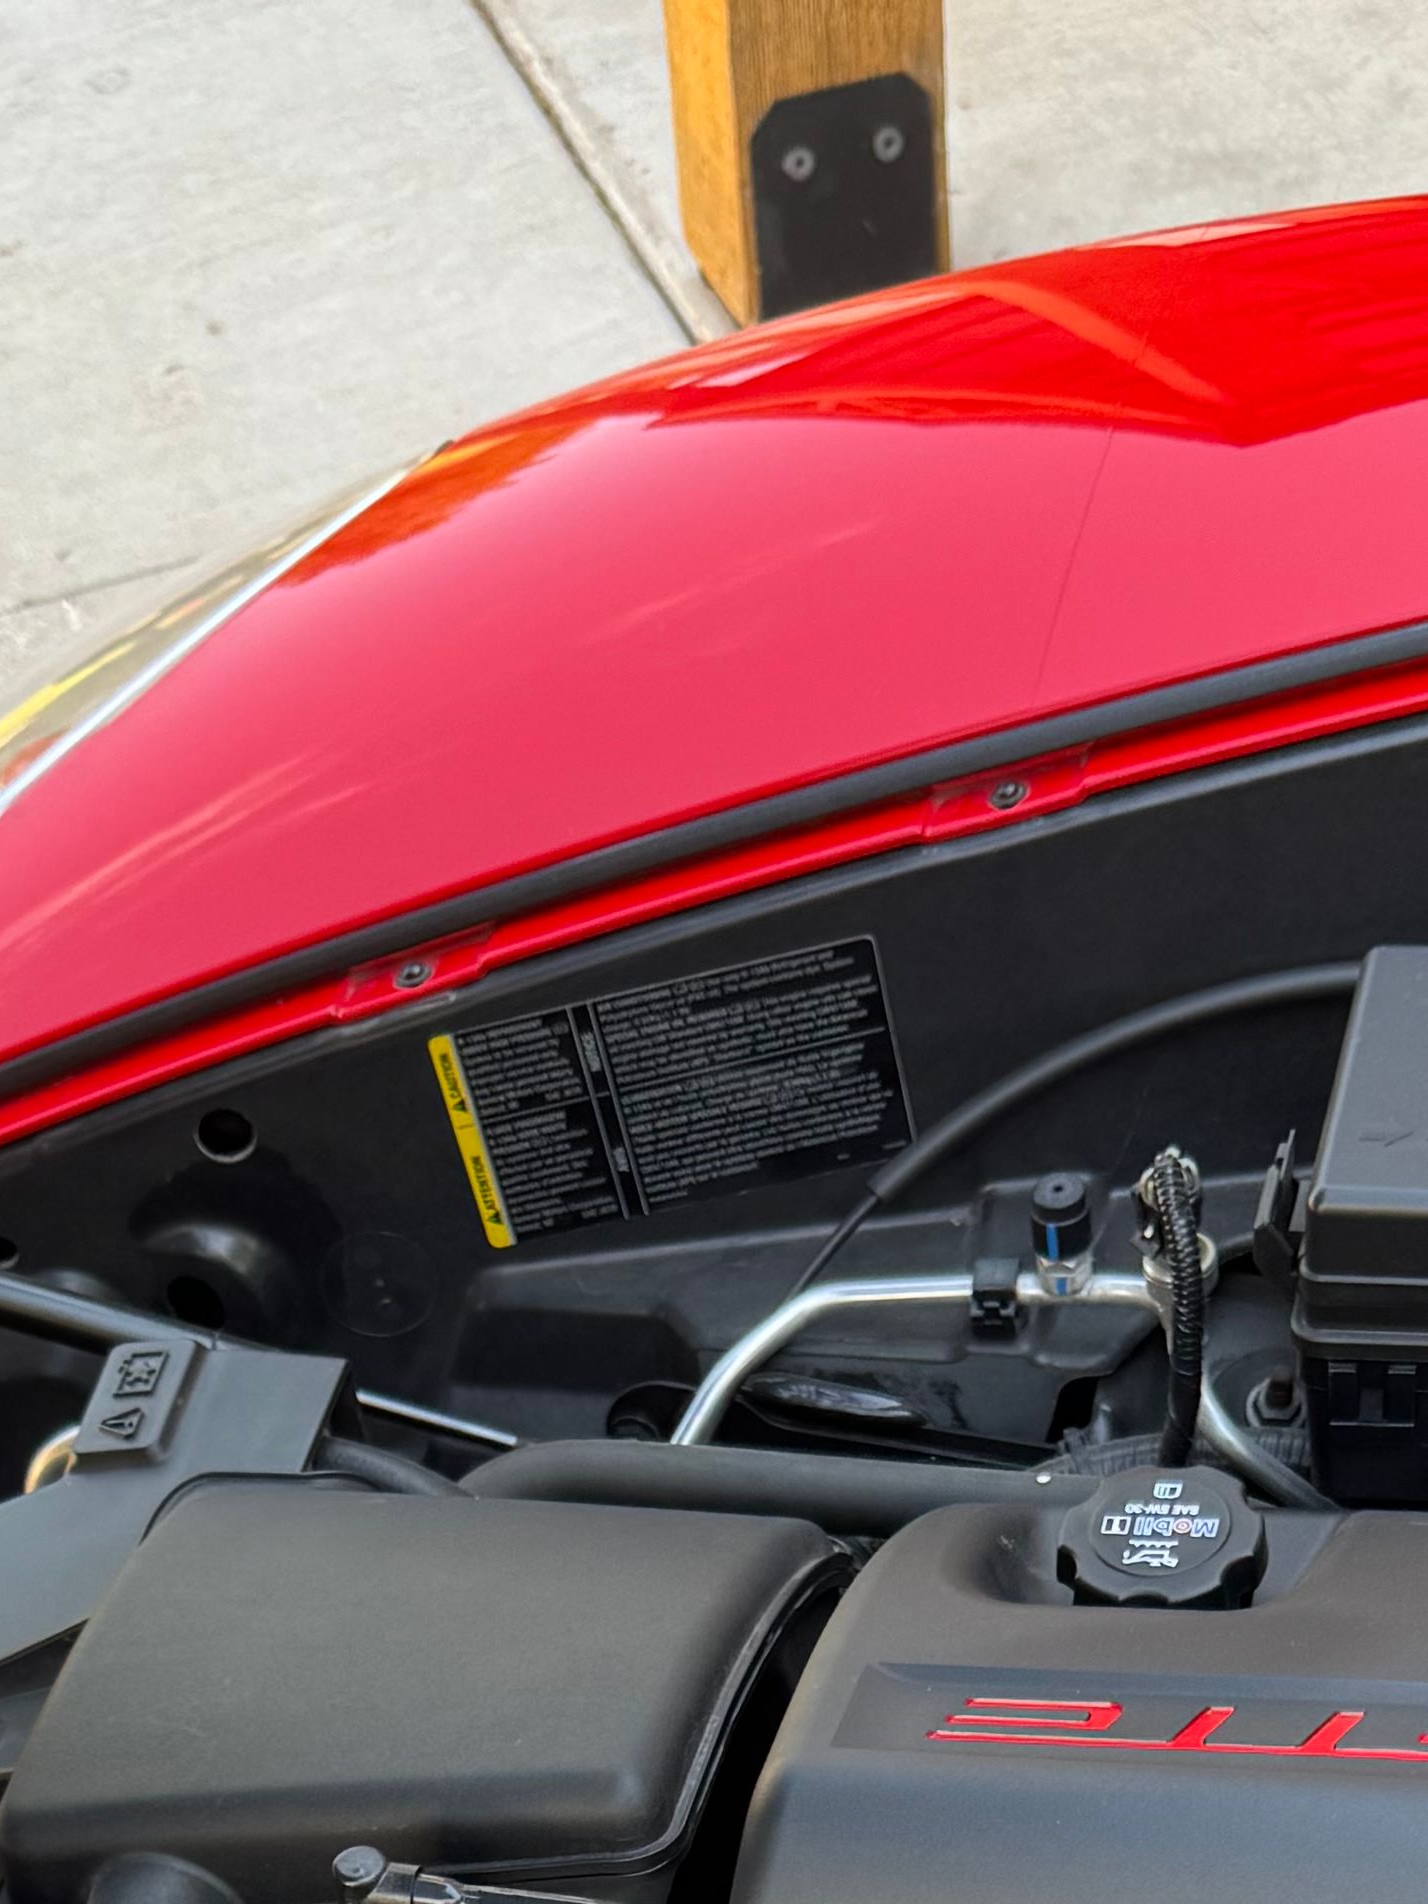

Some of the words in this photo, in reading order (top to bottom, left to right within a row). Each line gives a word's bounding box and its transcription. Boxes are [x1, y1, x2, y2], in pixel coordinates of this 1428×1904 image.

[1124, 1503, 1170, 1515] 5W-30
[1173, 1504, 1200, 1515] SAE
[1133, 1516, 1220, 1537] Mobil
